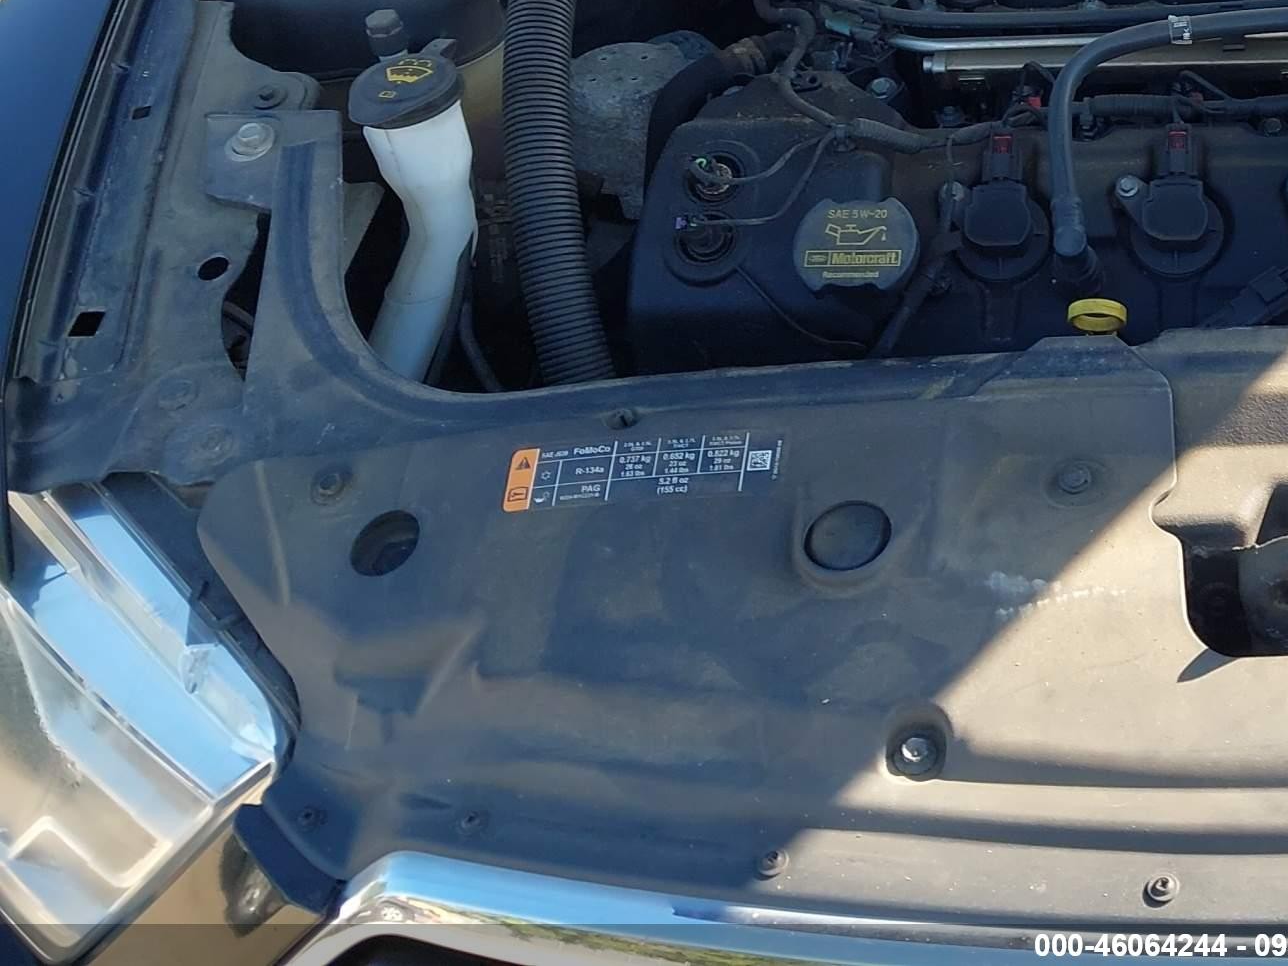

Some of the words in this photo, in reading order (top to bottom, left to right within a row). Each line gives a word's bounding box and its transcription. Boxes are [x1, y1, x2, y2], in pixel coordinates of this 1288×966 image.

[827, 209, 849, 219] SAE
[831, 252, 898, 265] Motorcraft
[573, 445, 611, 455] FoMoCo
[729, 448, 740, 458] kg
[641, 454, 651, 464] kg
[684, 451, 695, 461] kg
[575, 465, 605, 475] R-134a
[581, 484, 601, 493] PAG
[657, 485, 675, 495] (155
